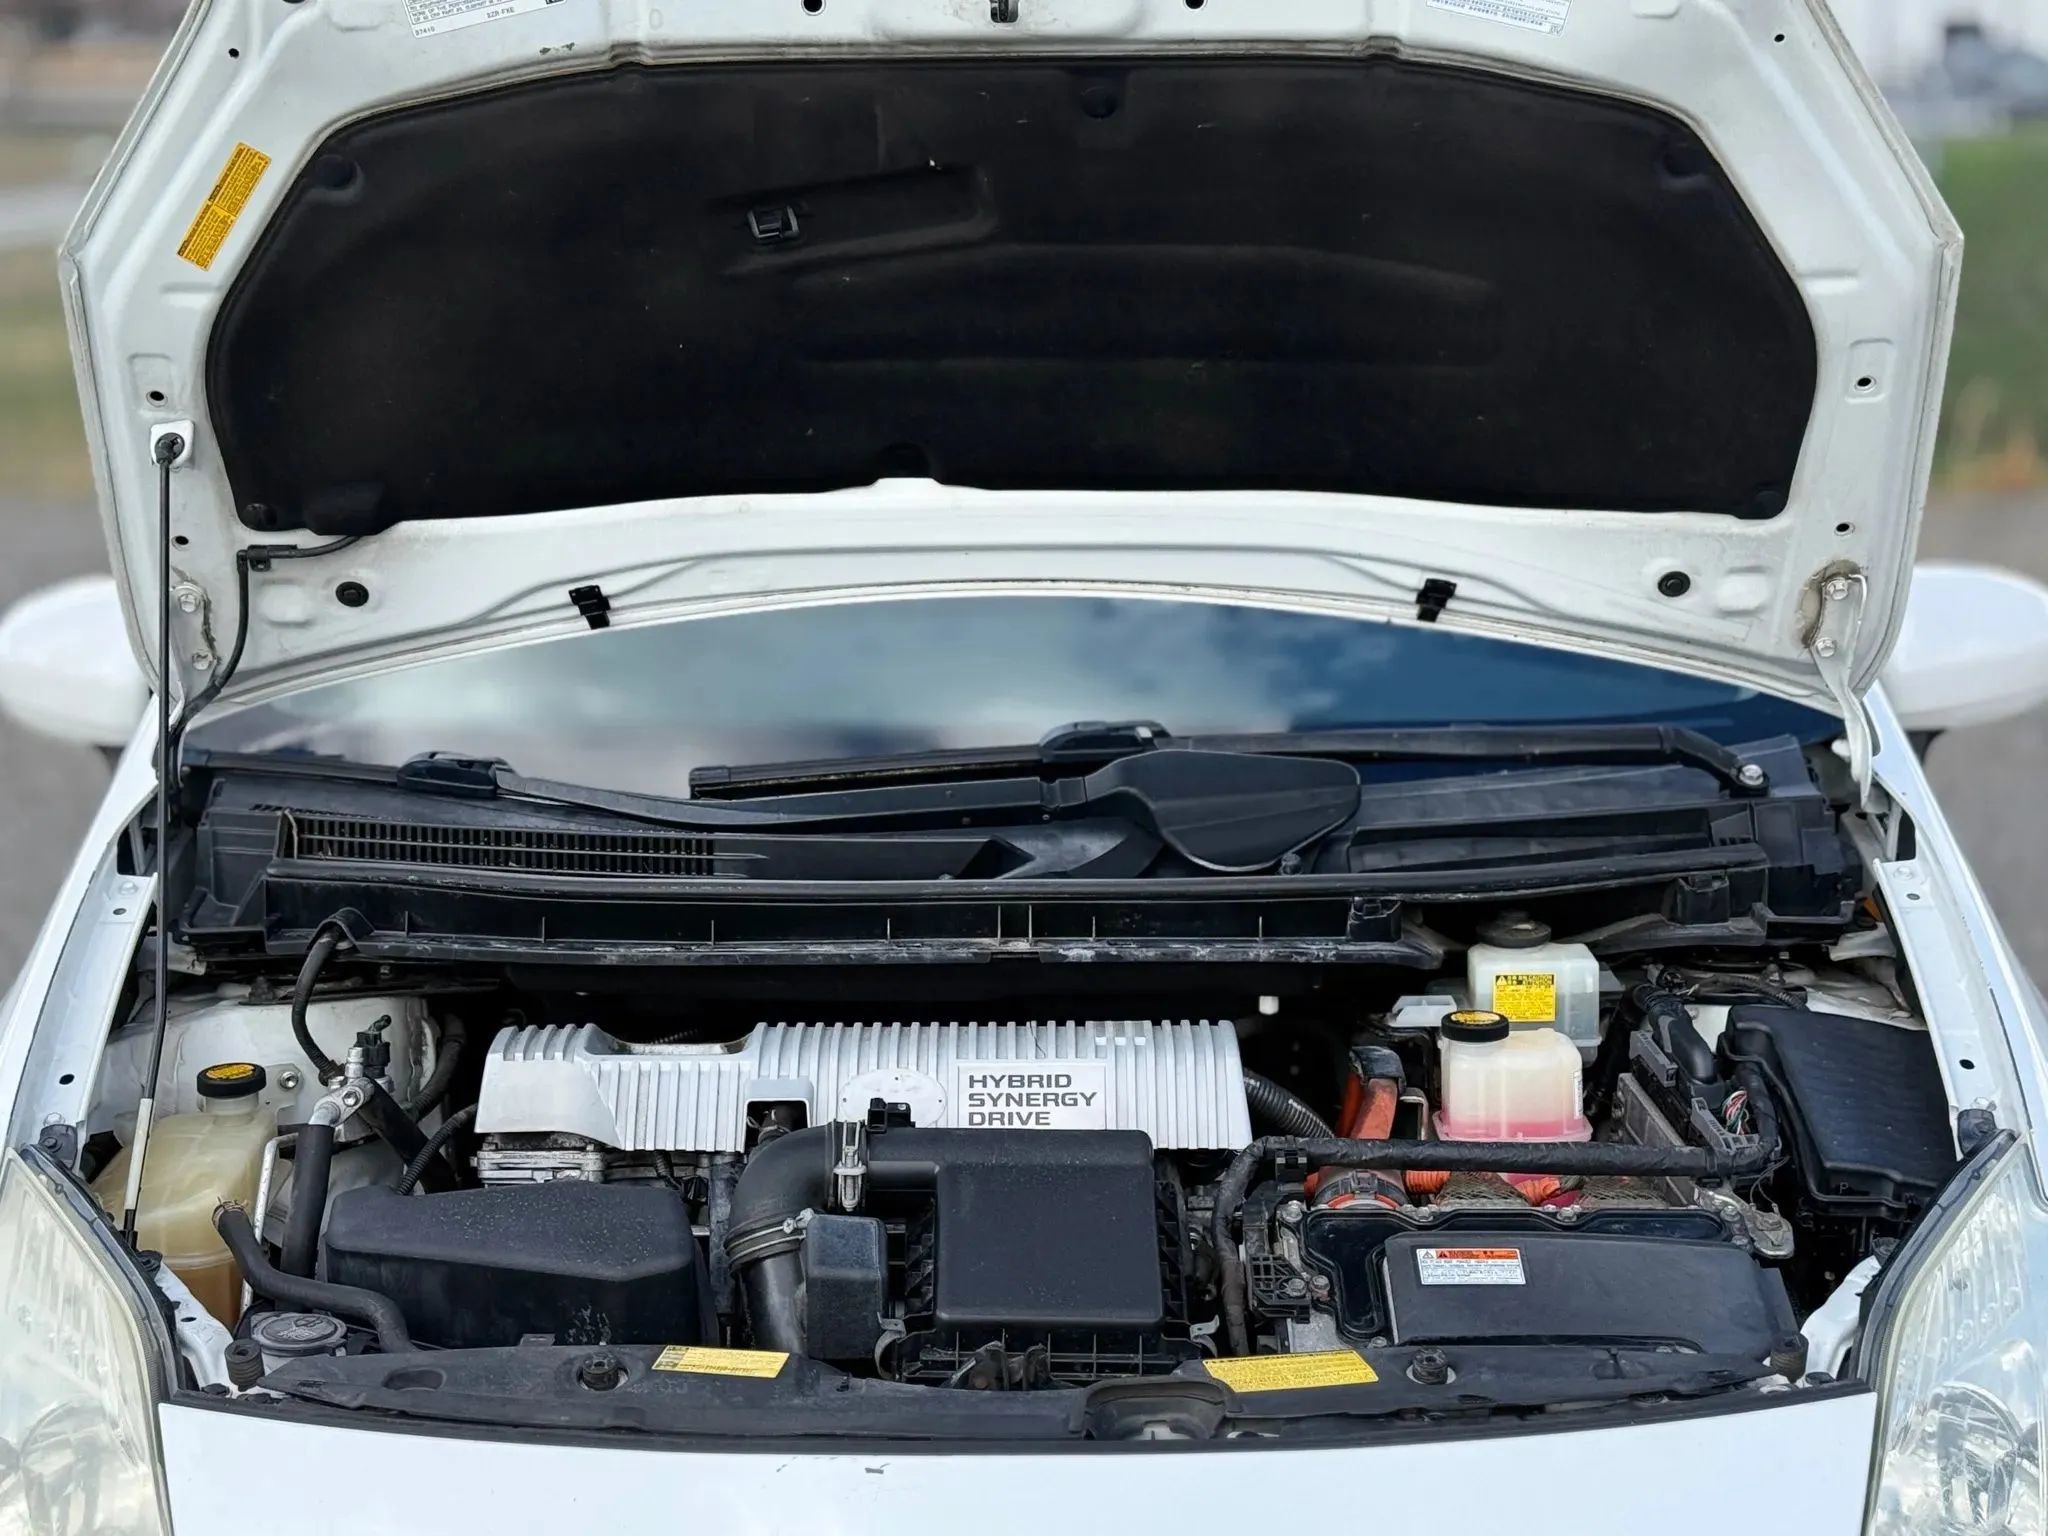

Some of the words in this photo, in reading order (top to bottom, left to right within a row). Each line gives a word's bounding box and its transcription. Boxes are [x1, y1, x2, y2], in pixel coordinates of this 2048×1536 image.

[968, 1074, 1072, 1088] HYBRID
[968, 1092, 1097, 1107] SYNERGY
[968, 1111, 1050, 1125] DRIVE
